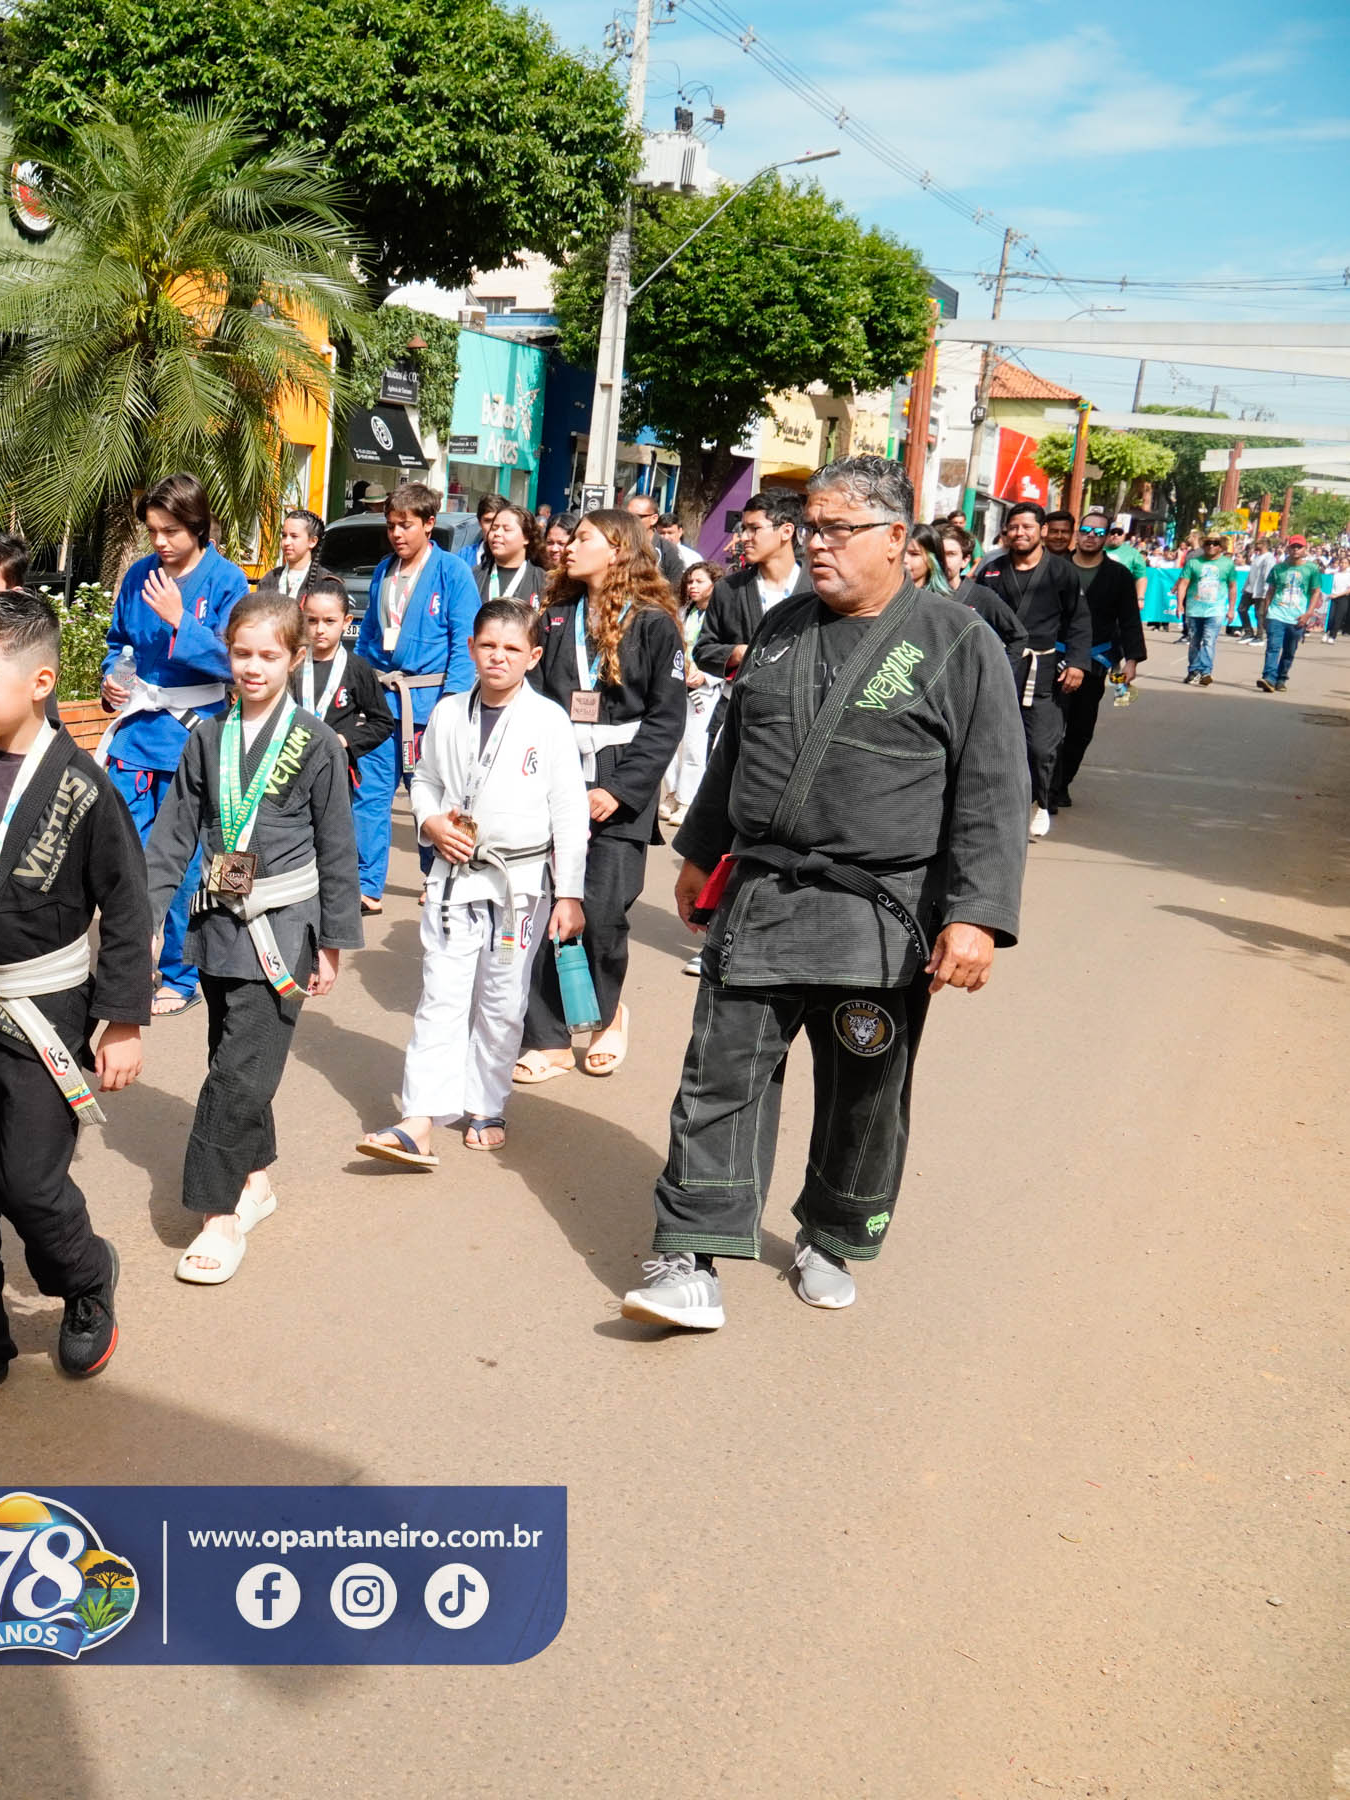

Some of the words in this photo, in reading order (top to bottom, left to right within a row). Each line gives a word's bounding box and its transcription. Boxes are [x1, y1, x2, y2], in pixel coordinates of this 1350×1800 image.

[855, 641, 925, 711] VENUM
[263, 726, 312, 796] VENUM
[12, 769, 88, 878] VIRTUS
[40, 847, 67, 893] ESCOLA
[76, 786, 100, 819] JITSU
[845, 1003, 880, 1014] VIRTUS
